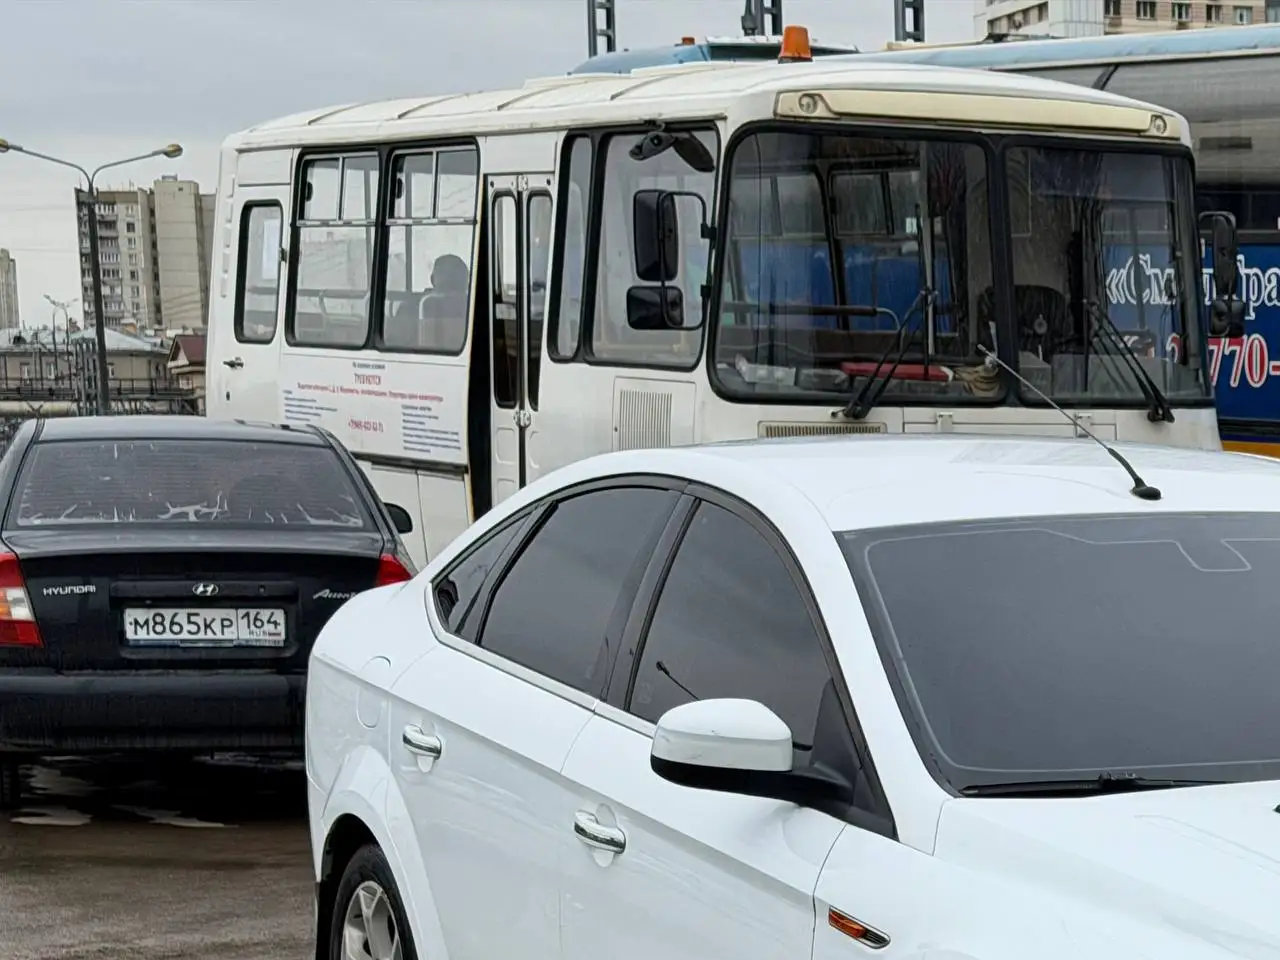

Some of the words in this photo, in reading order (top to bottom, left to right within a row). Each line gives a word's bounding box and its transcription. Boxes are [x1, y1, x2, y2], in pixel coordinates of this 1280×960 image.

[43, 585, 96, 596] HYUNDAI
[133, 611, 234, 637] М865КР
[241, 611, 280, 630] 164
